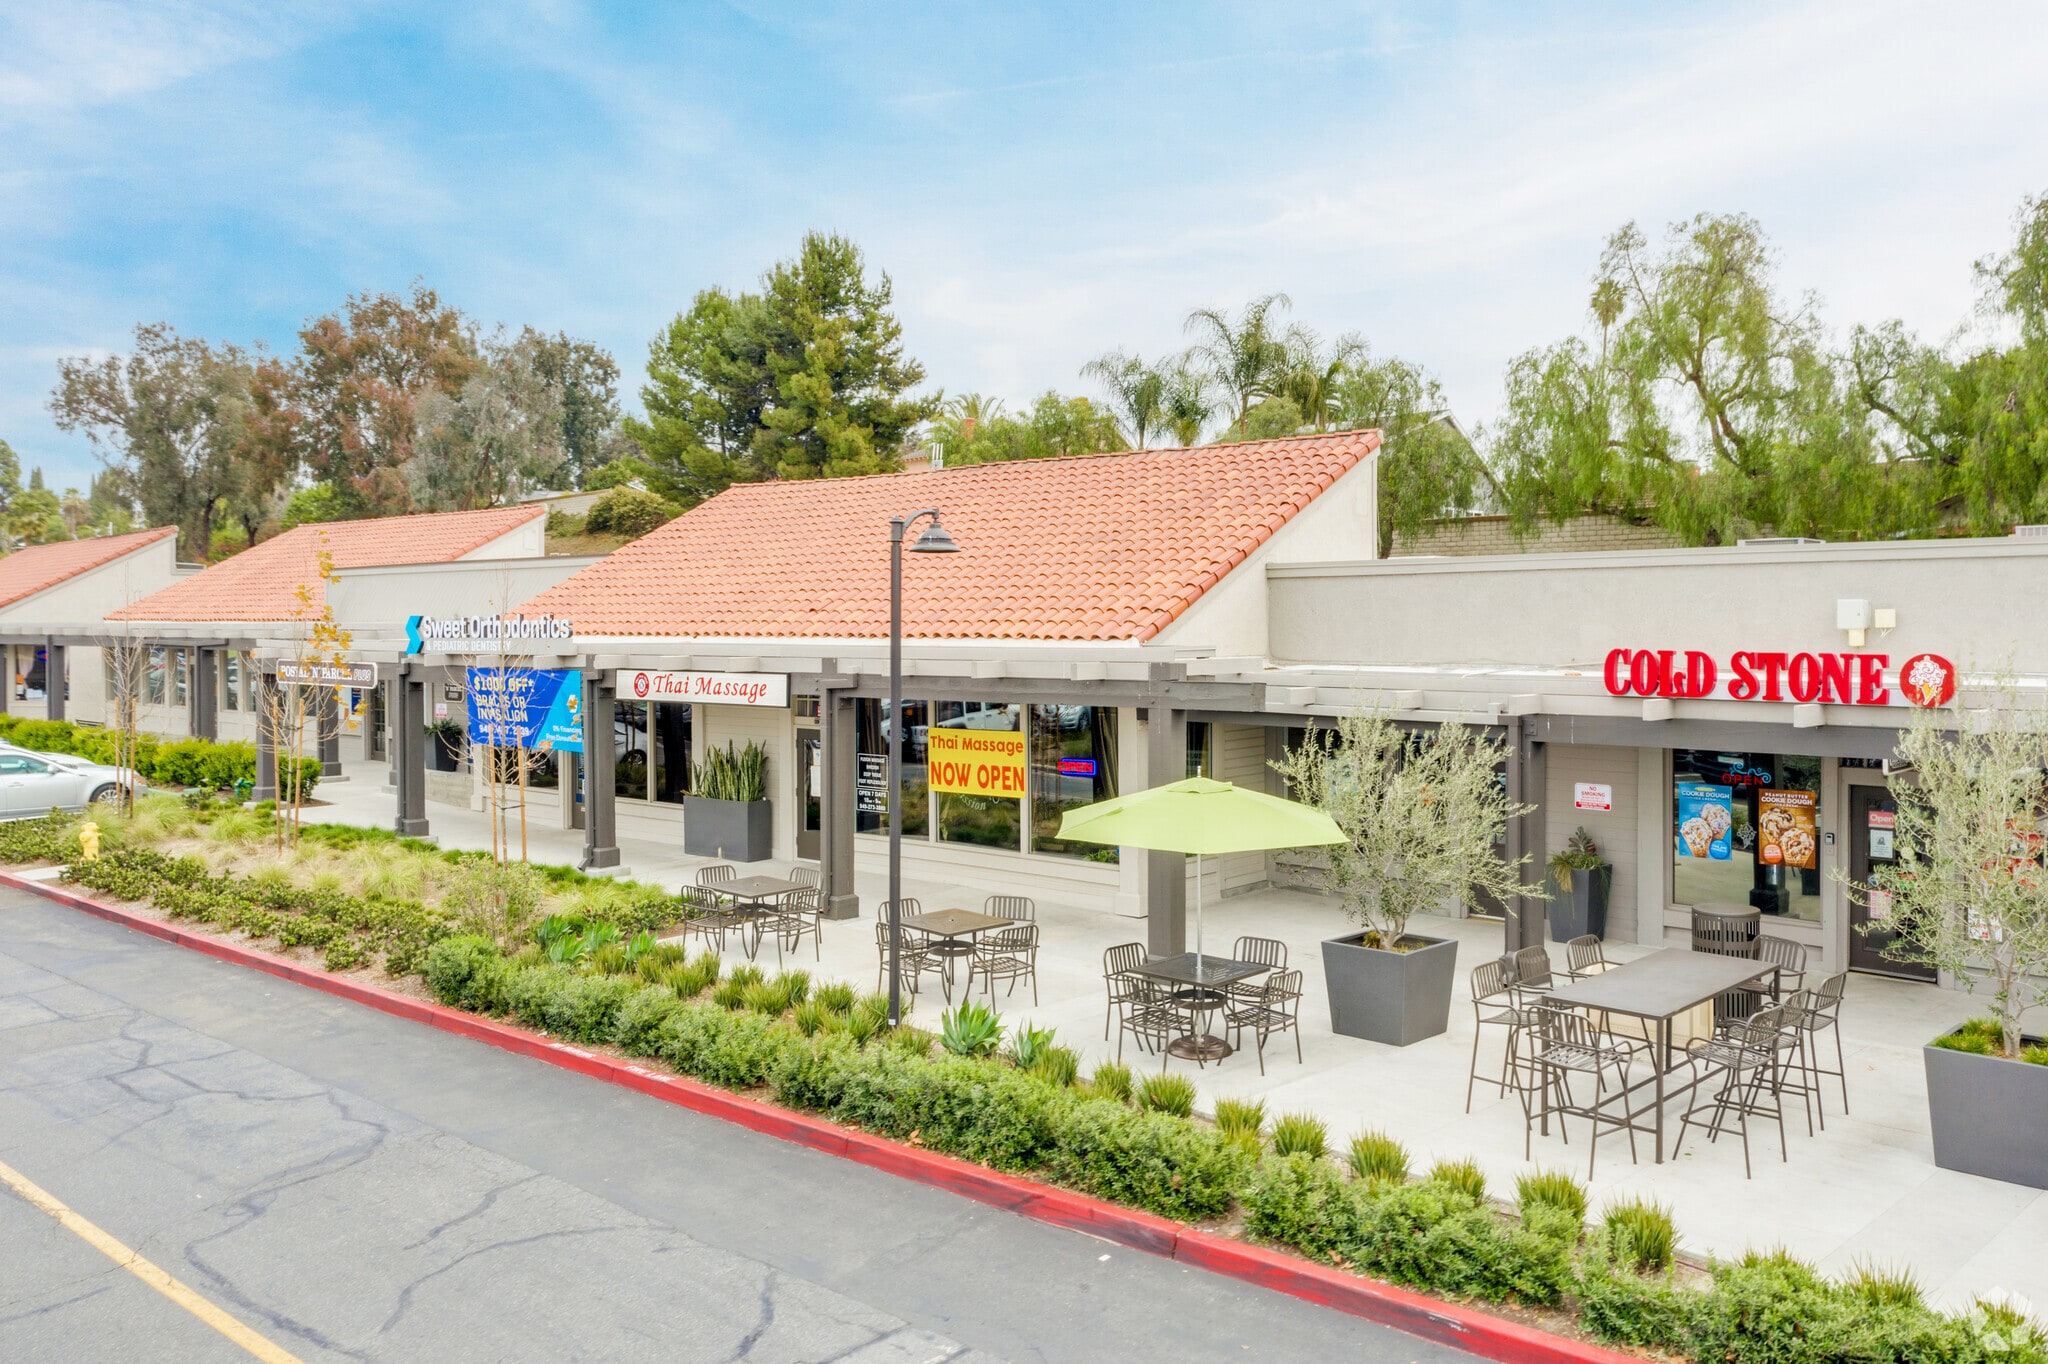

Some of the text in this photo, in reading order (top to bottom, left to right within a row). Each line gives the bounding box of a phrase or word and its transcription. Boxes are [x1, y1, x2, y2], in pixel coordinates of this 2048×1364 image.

[423, 613, 573, 639] Sweet Orthodontics
[433, 640, 469, 651] PEDIATRIC
[1604, 648, 1890, 705] COLD STONE
[653, 673, 690, 695] Thai
[694, 677, 768, 704] Massage
[476, 693, 527, 710] BRACS OR
[930, 735, 1024, 757] Thai Massage
[1057, 761, 1093, 773] OPEN
[930, 761, 1025, 792] NOW OPEN
[1721, 773, 1764, 786] OPEN
[1761, 796, 1813, 806] COOKIE DOUGH
[1870, 813, 1894, 824] Open
